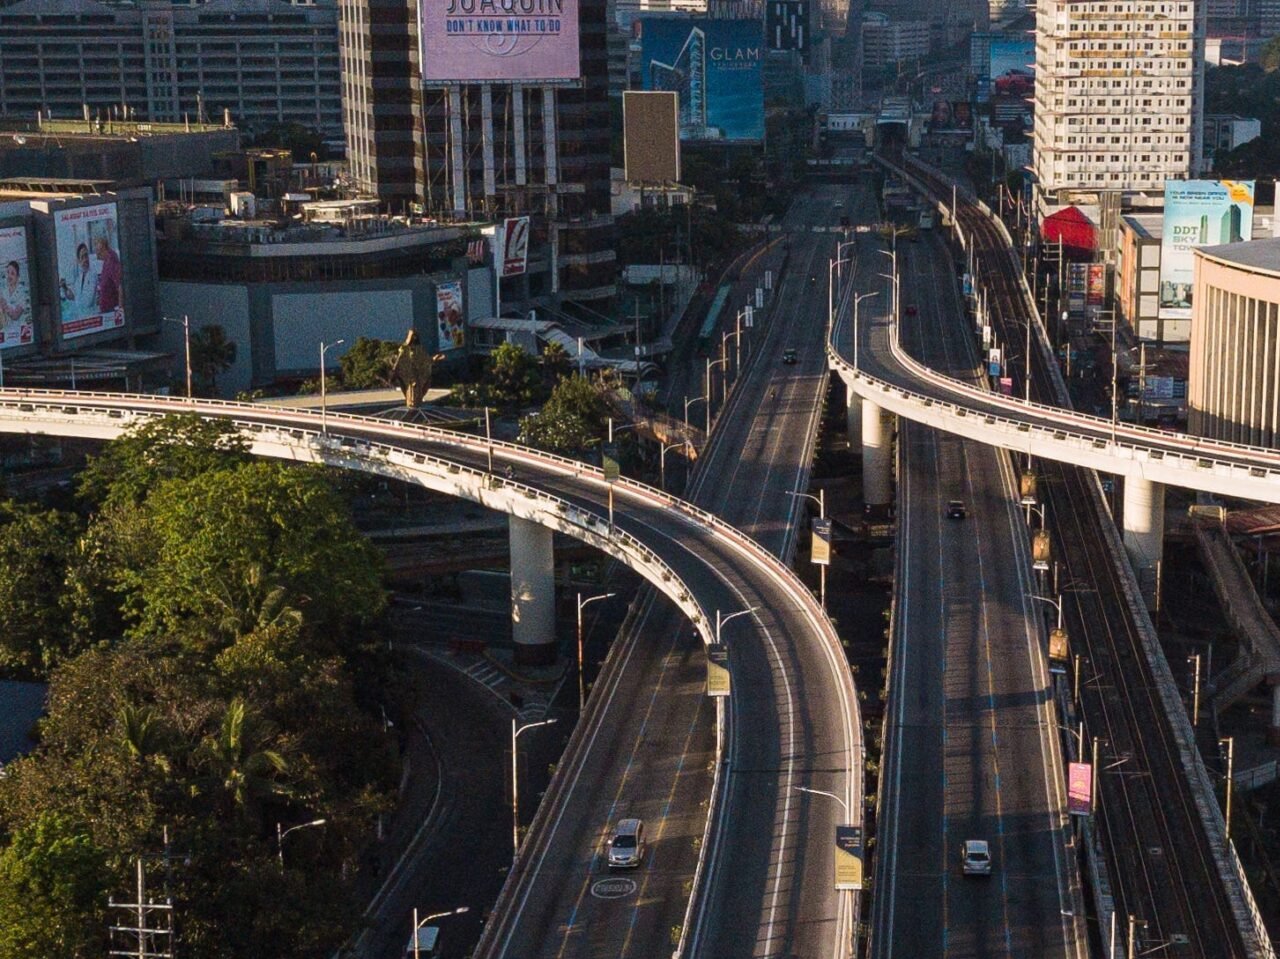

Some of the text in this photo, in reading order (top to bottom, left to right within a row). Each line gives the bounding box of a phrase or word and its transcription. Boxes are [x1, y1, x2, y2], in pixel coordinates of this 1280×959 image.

[446, 19, 473, 32] DON'T
[477, 19, 503, 32] KNOW
[506, 19, 531, 32] WHAT
[535, 19, 546, 32] TO
[711, 48, 759, 61] GLAM
[1173, 226, 1199, 235] DDT
